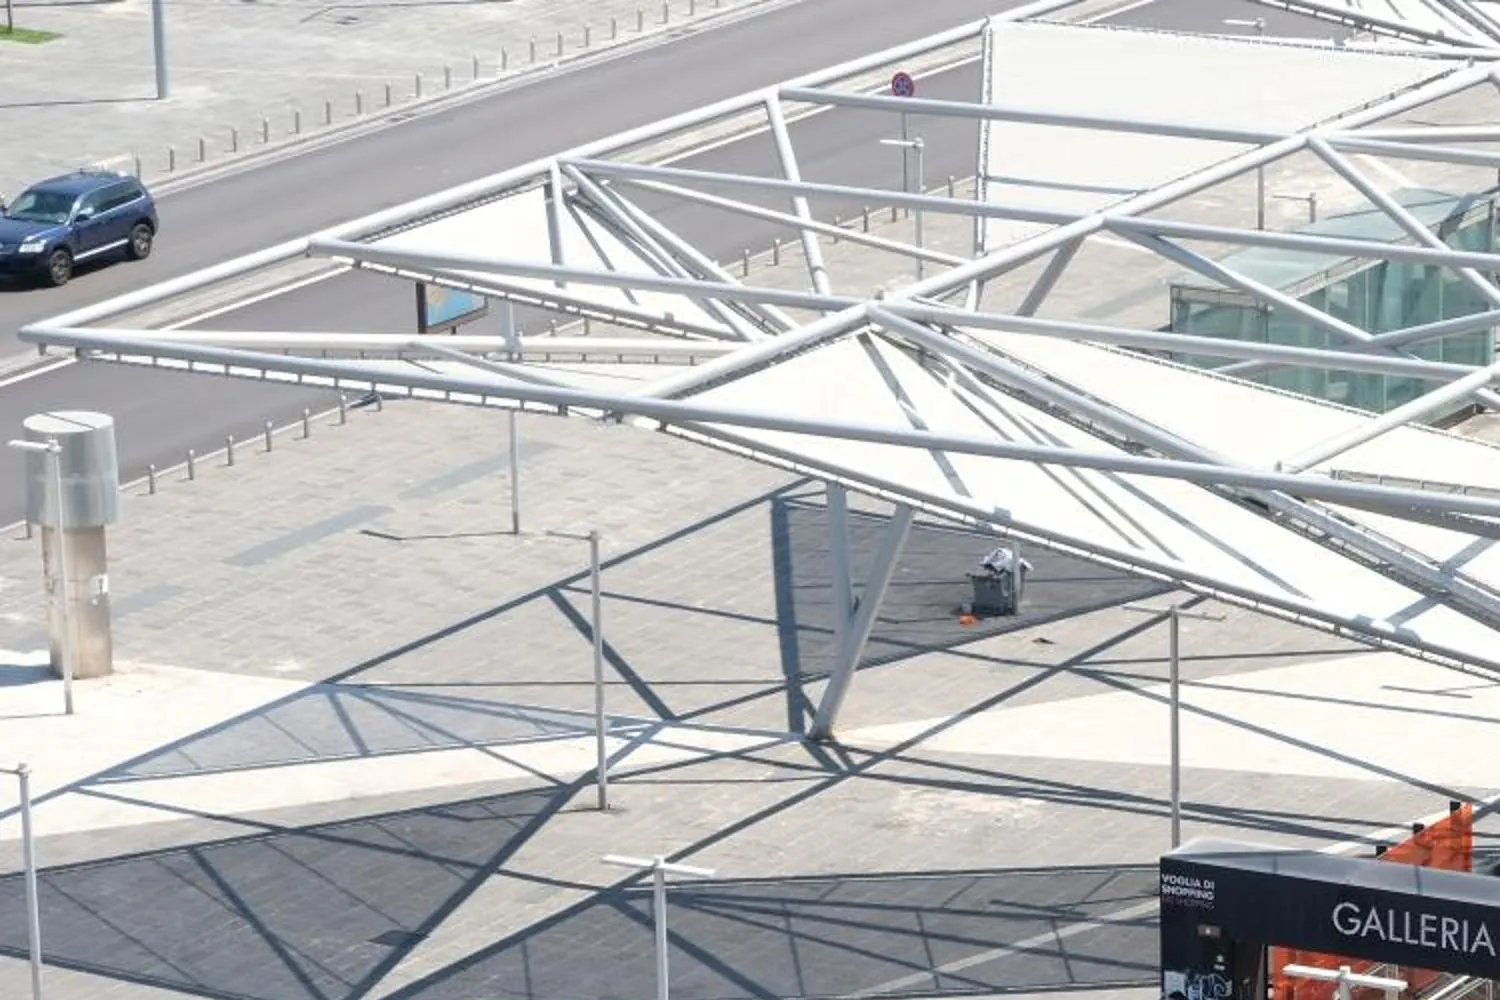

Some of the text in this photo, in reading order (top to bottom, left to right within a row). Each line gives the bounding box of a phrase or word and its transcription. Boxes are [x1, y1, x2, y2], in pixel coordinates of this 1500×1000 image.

[1161, 873, 1215, 890] VOGLIA DI
[1161, 884, 1215, 901] SHOPPING
[1332, 901, 1497, 957] GALLERIA
